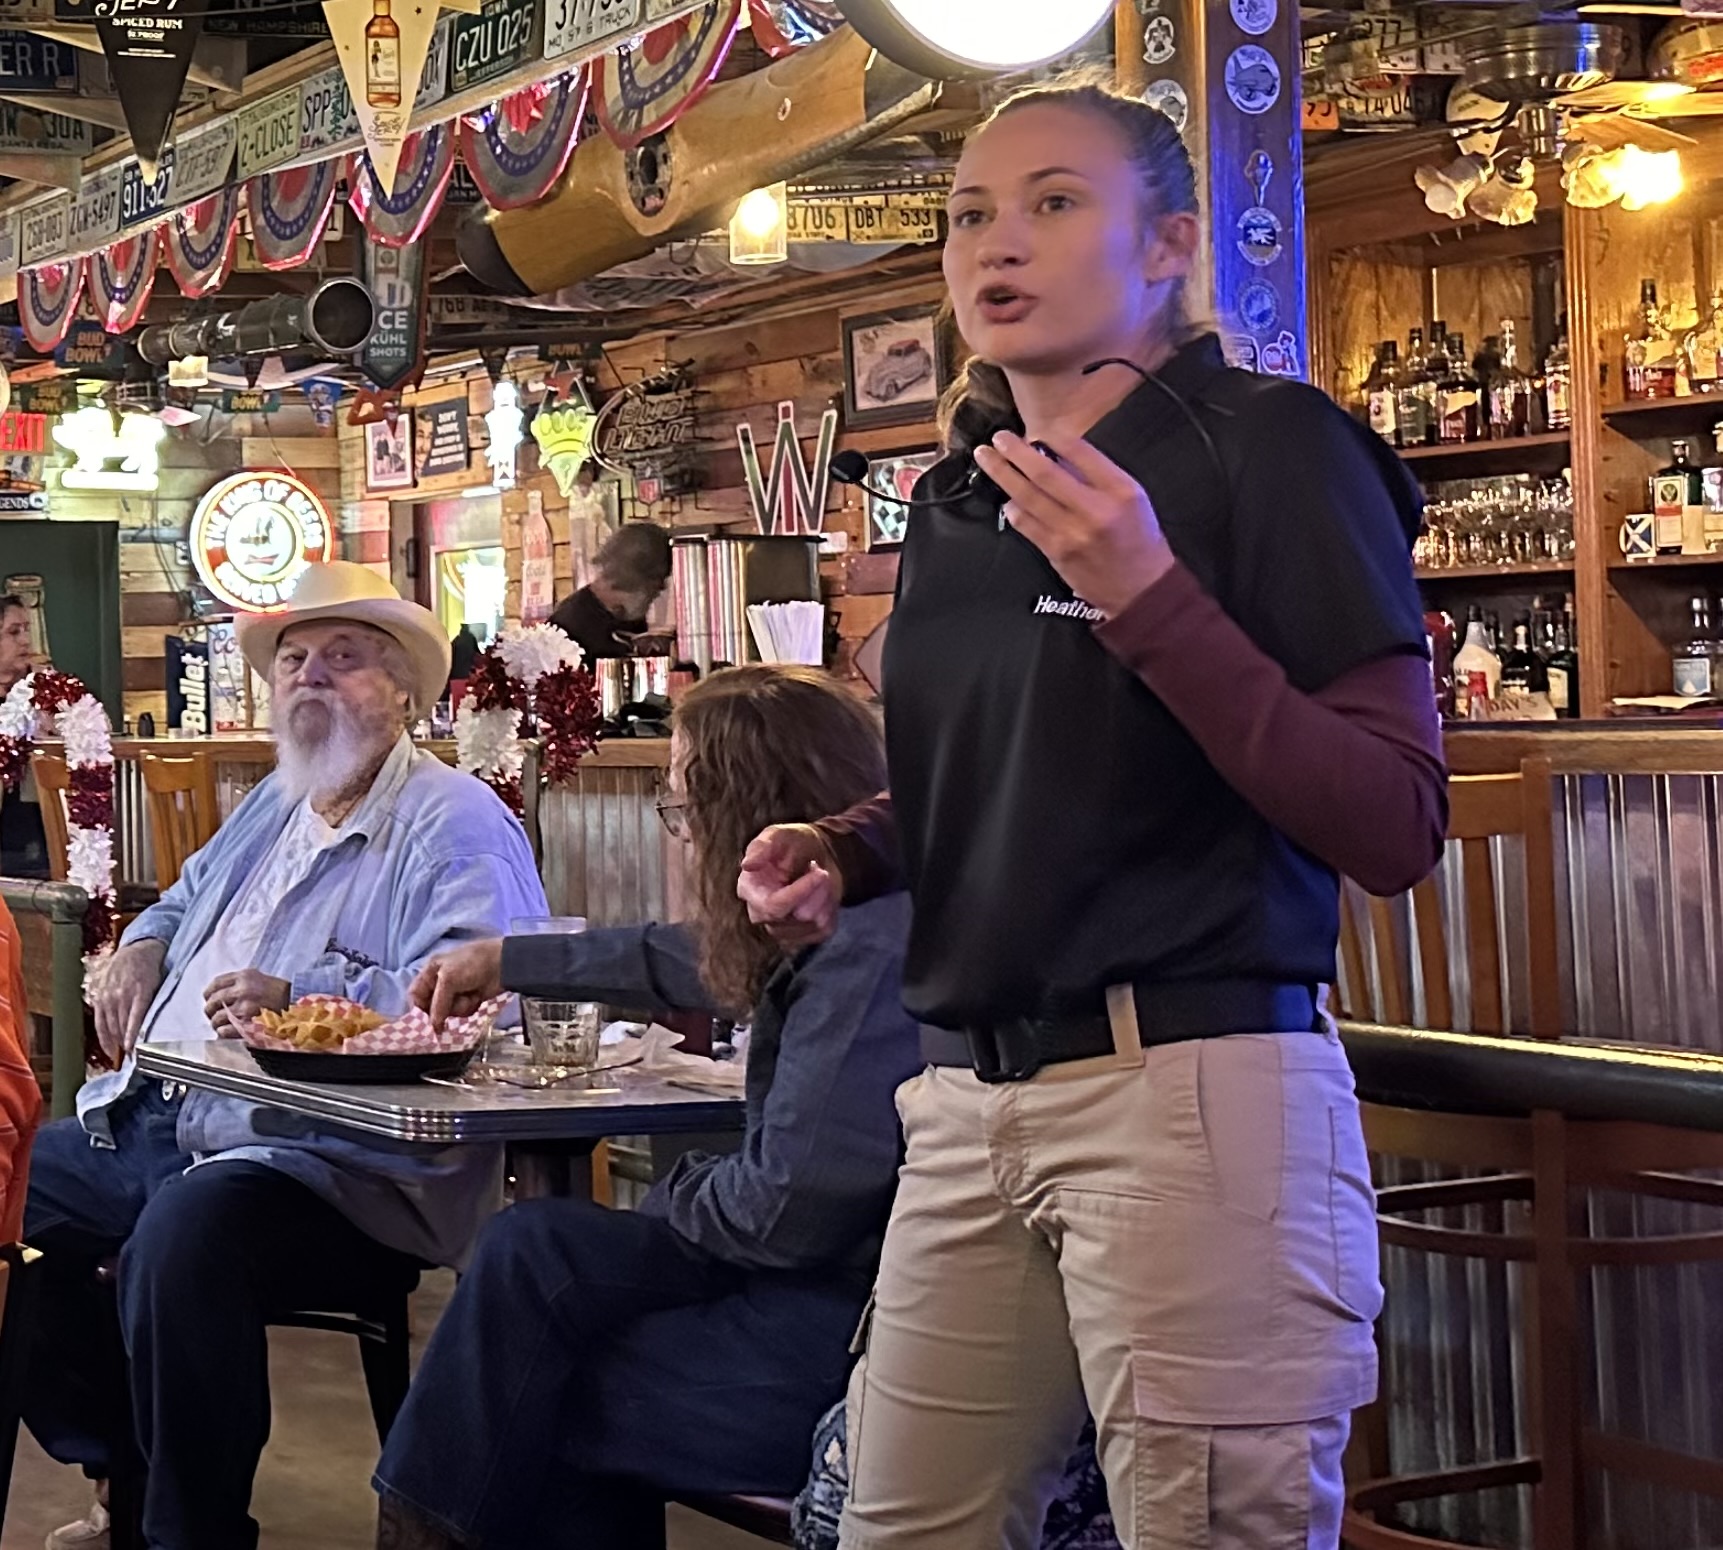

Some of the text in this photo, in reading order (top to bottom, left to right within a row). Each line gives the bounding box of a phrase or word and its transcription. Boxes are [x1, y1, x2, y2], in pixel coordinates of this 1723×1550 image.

[155, 18, 183, 29] RUM
[456, 20, 493, 72] CZU
[498, 2, 534, 56] 025
[303, 89, 332, 133] SPP
[241, 109, 296, 168] 2-CLOSE
[901, 208, 931, 227] 533
[378, 310, 409, 330] CE
[77, 331, 106, 346] BUD
[370, 330, 407, 345] KÜHL
[370, 347, 406, 357] SHOTS
[616, 397, 686, 428] BUD
[0, 411, 47, 452] EXIT
[263, 479, 292, 502] OF
